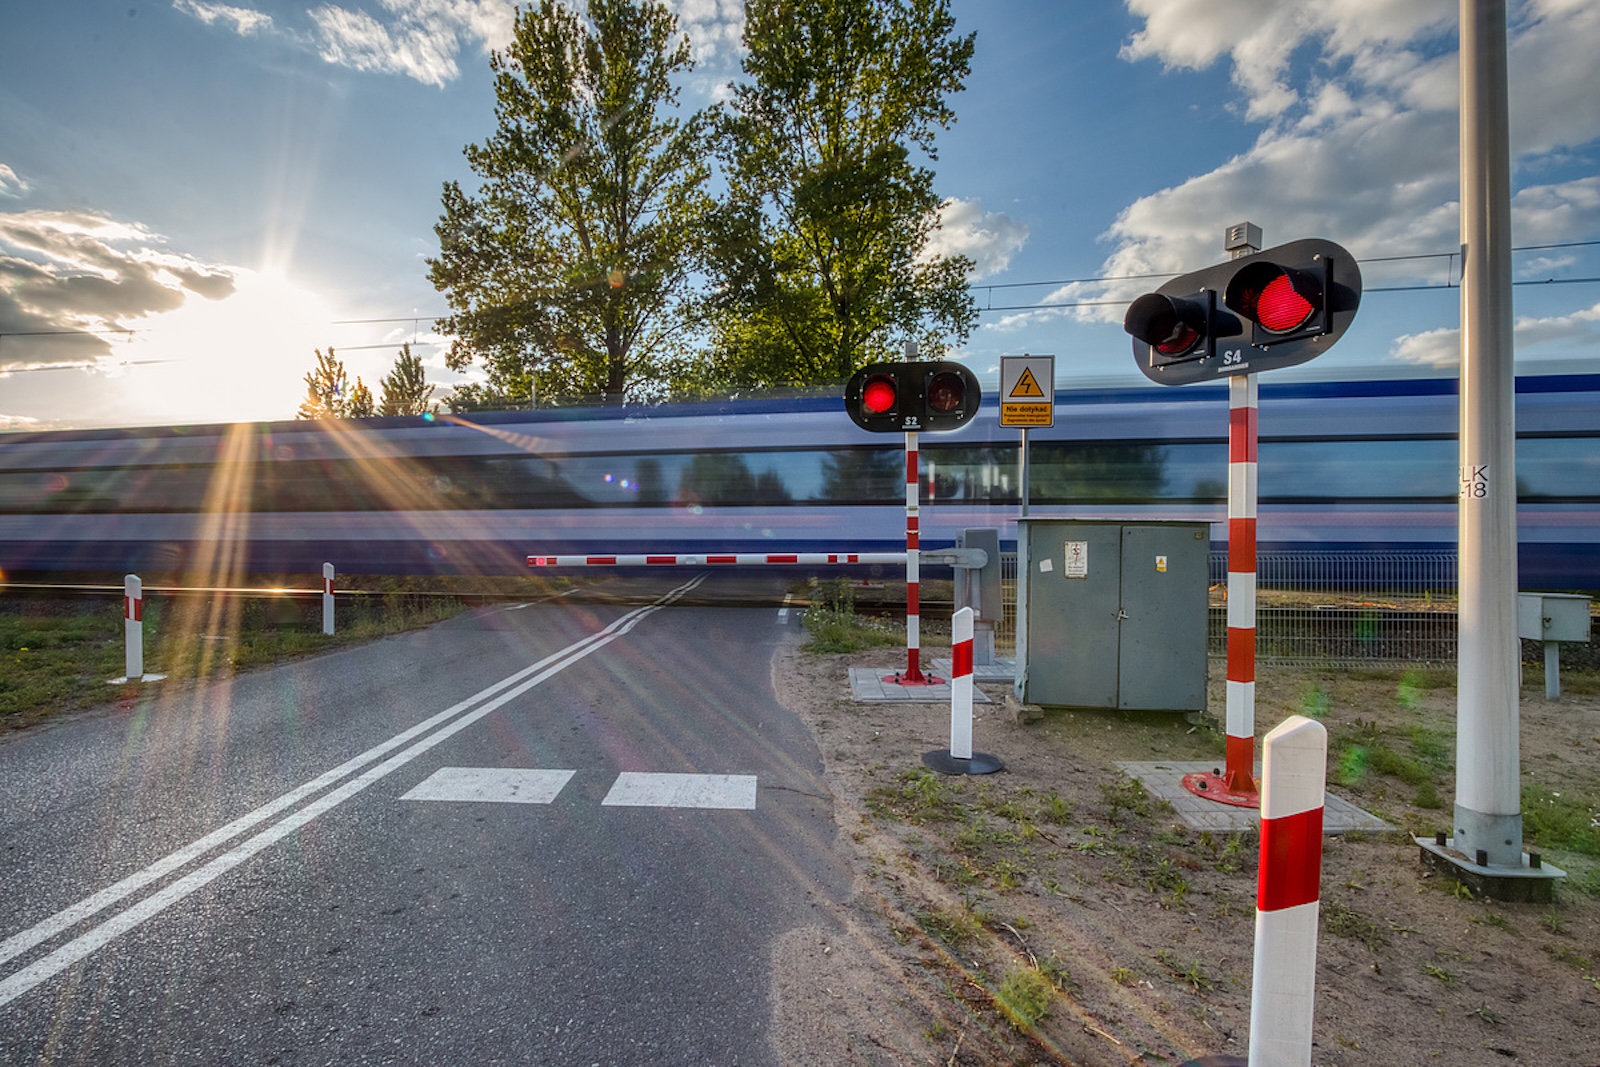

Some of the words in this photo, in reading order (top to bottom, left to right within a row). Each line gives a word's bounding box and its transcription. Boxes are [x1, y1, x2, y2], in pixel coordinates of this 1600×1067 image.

[1223, 349, 1242, 365] S4
[904, 416, 918, 425] S2
[1459, 465, 1489, 482] LK
[1459, 482, 1487, 498] -18
